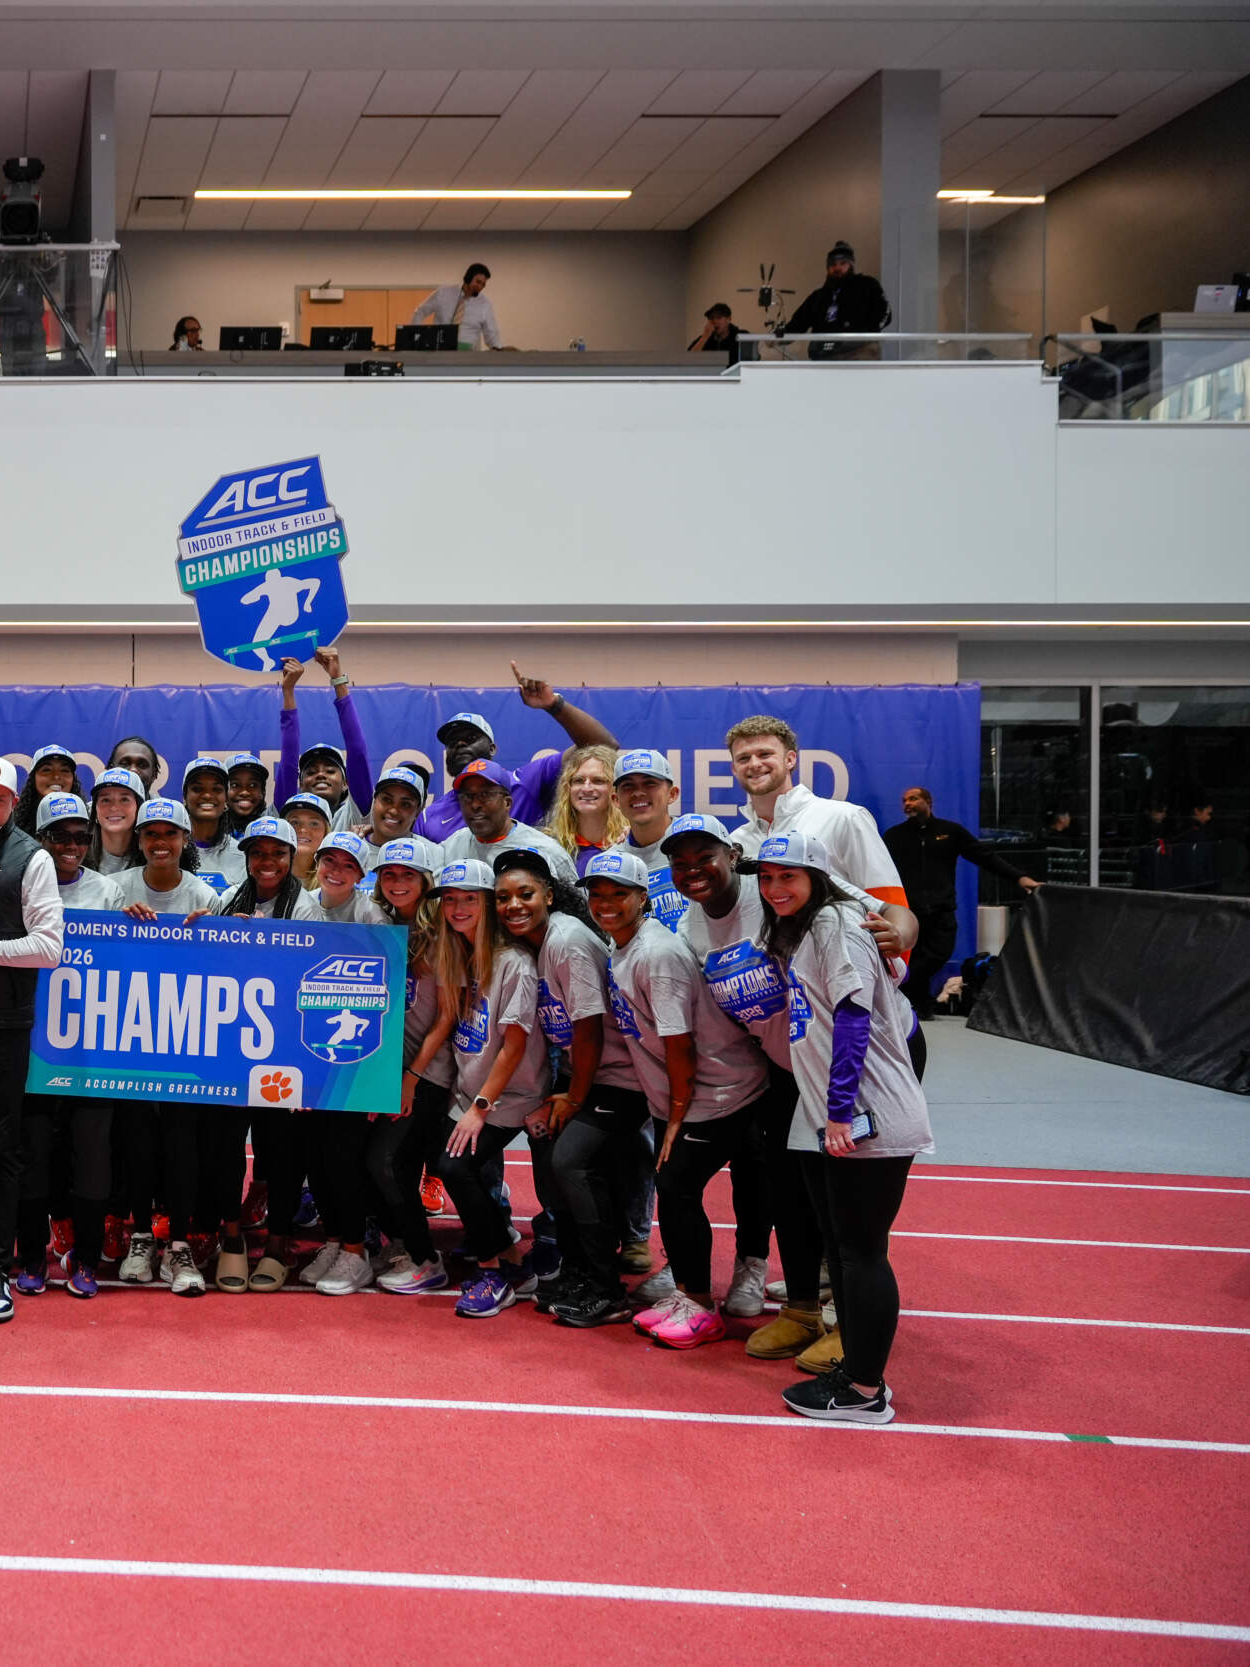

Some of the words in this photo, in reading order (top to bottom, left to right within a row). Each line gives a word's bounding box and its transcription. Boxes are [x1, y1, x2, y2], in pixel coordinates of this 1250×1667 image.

[203, 466, 311, 519] ACC
[187, 533, 233, 554] INDOOR
[236, 521, 277, 542] TRACK
[281, 520, 289, 531] &
[294, 512, 326, 528] FIELD
[185, 527, 341, 585] CHAMPIONSHIPS
[648, 872, 661, 884] CC
[63, 922, 128, 938] OMEN'S
[132, 925, 193, 941] INDOOR
[198, 929, 251, 944] TRACK
[256, 932, 266, 945] &
[272, 933, 315, 947] FIELD
[62, 947, 94, 965] 026
[717, 947, 741, 965] ACC
[318, 959, 379, 978] ACC
[305, 983, 330, 991] INDOOR
[332, 984, 354, 992] TRACK
[300, 995, 386, 1008] CHAMPIONSHIPS
[46, 967, 276, 1060] CHAMPS
[47, 1077, 73, 1086] ACC
[84, 1078, 163, 1093] ACCOMPLISH
[168, 1084, 238, 1097] GREATNESS
